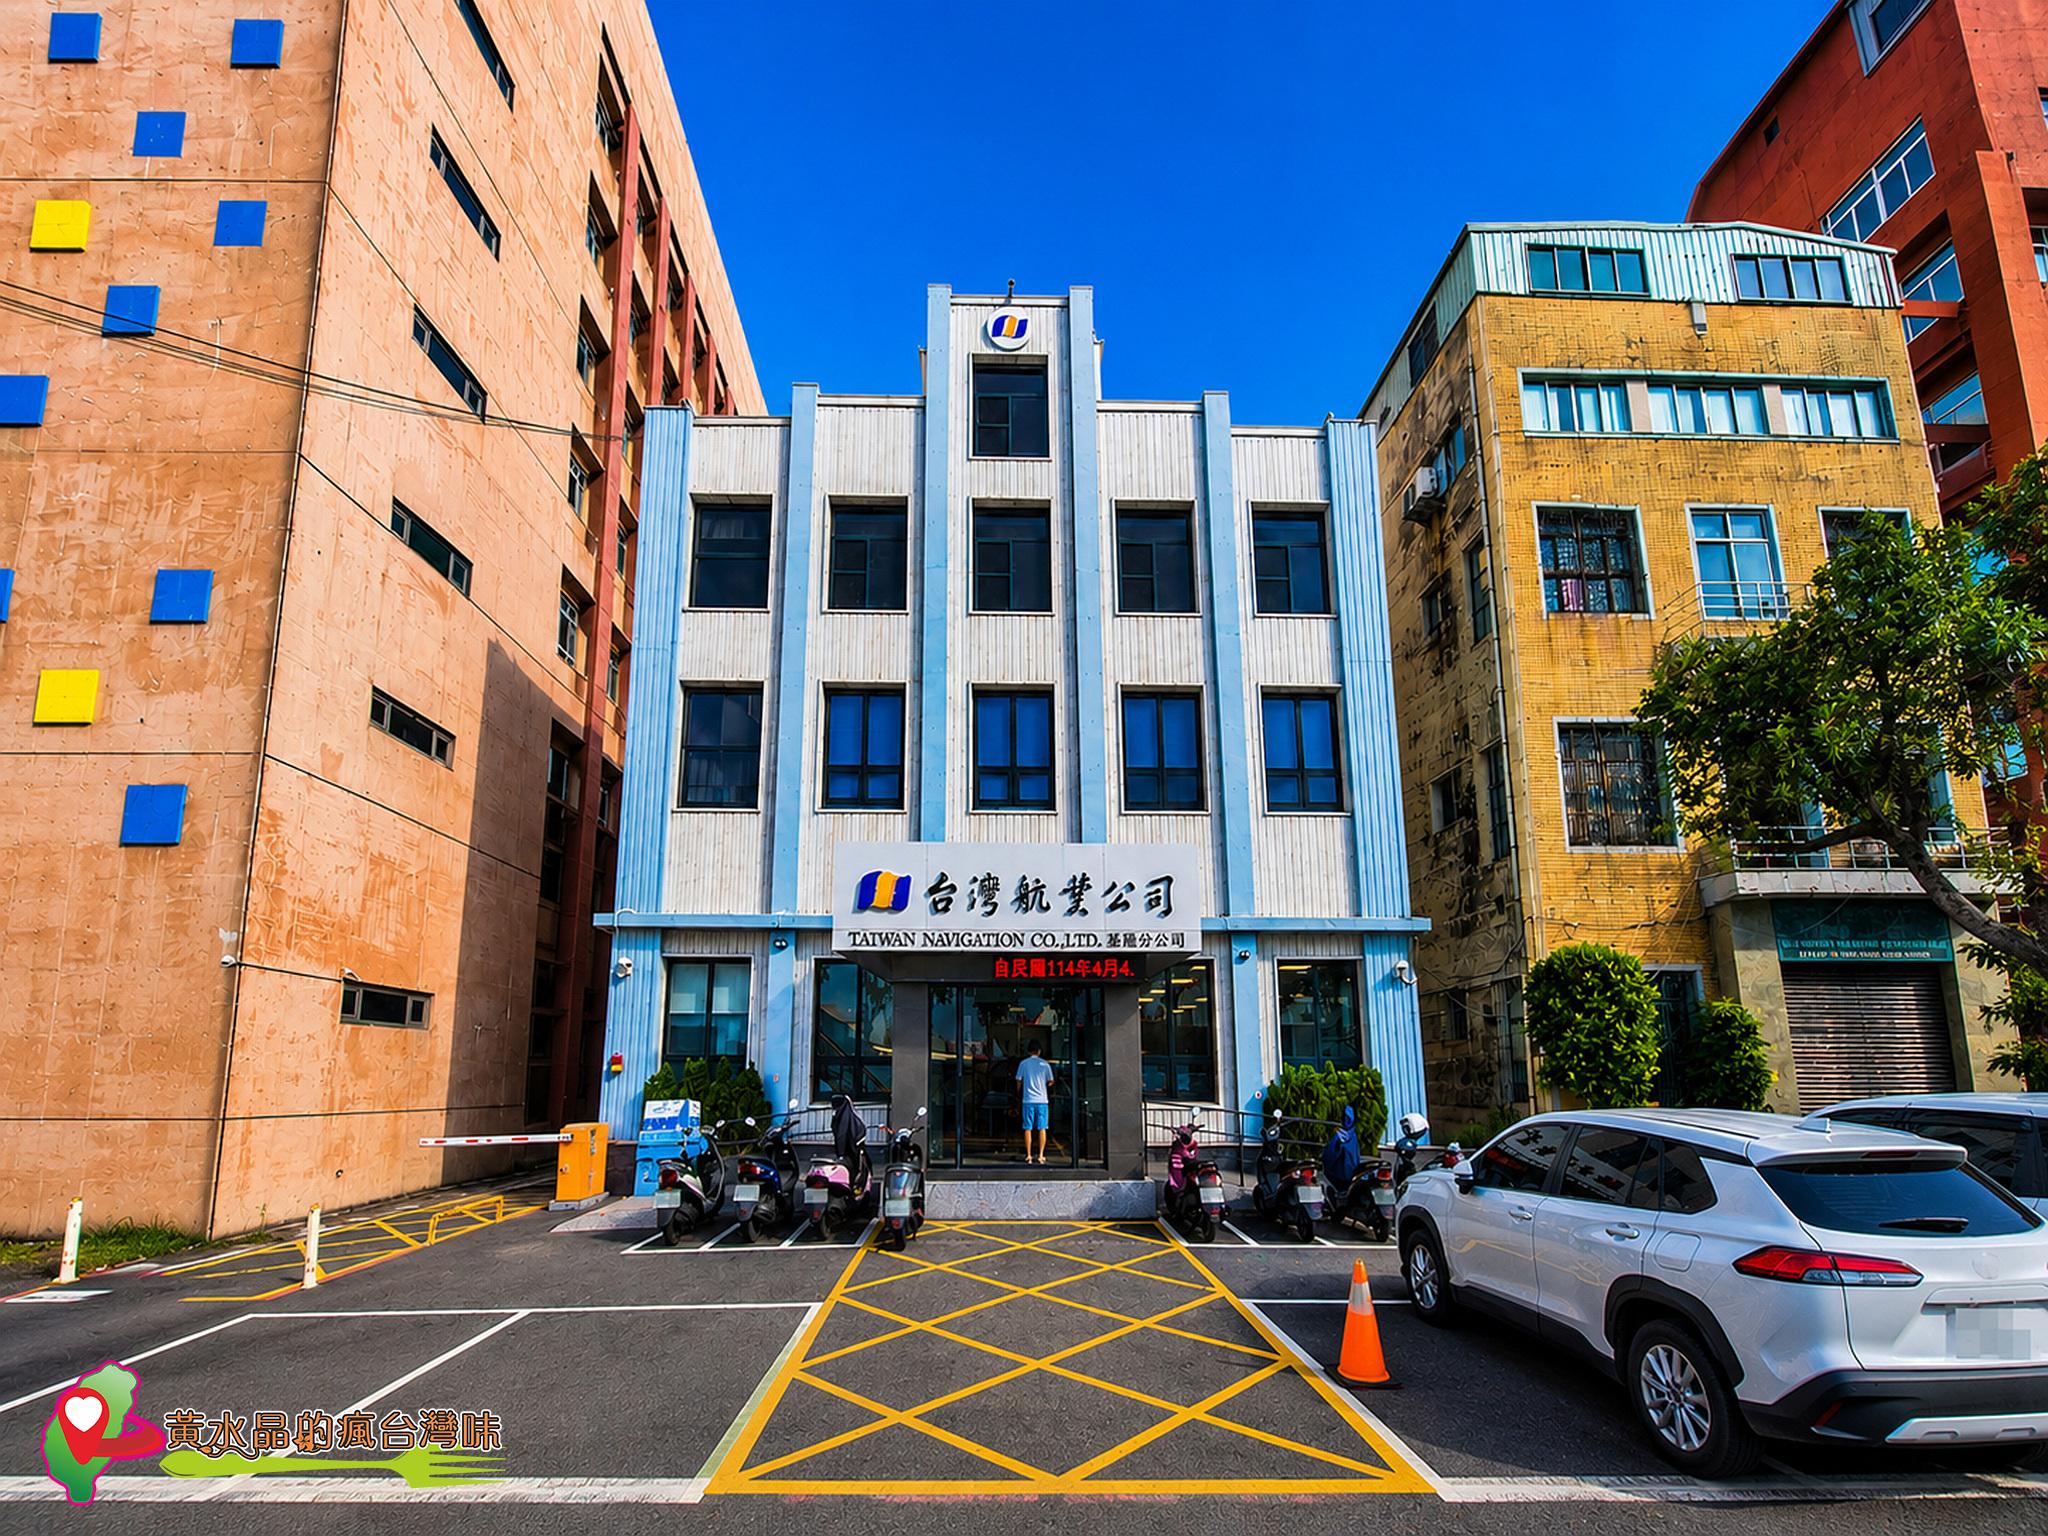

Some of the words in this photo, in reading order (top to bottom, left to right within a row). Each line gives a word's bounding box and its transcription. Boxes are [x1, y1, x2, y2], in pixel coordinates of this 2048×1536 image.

[926, 871, 1175, 918] 台灣航業公司
[848, 931, 915, 947] TAIWAN
[921, 931, 1026, 948] NAVIGATION
